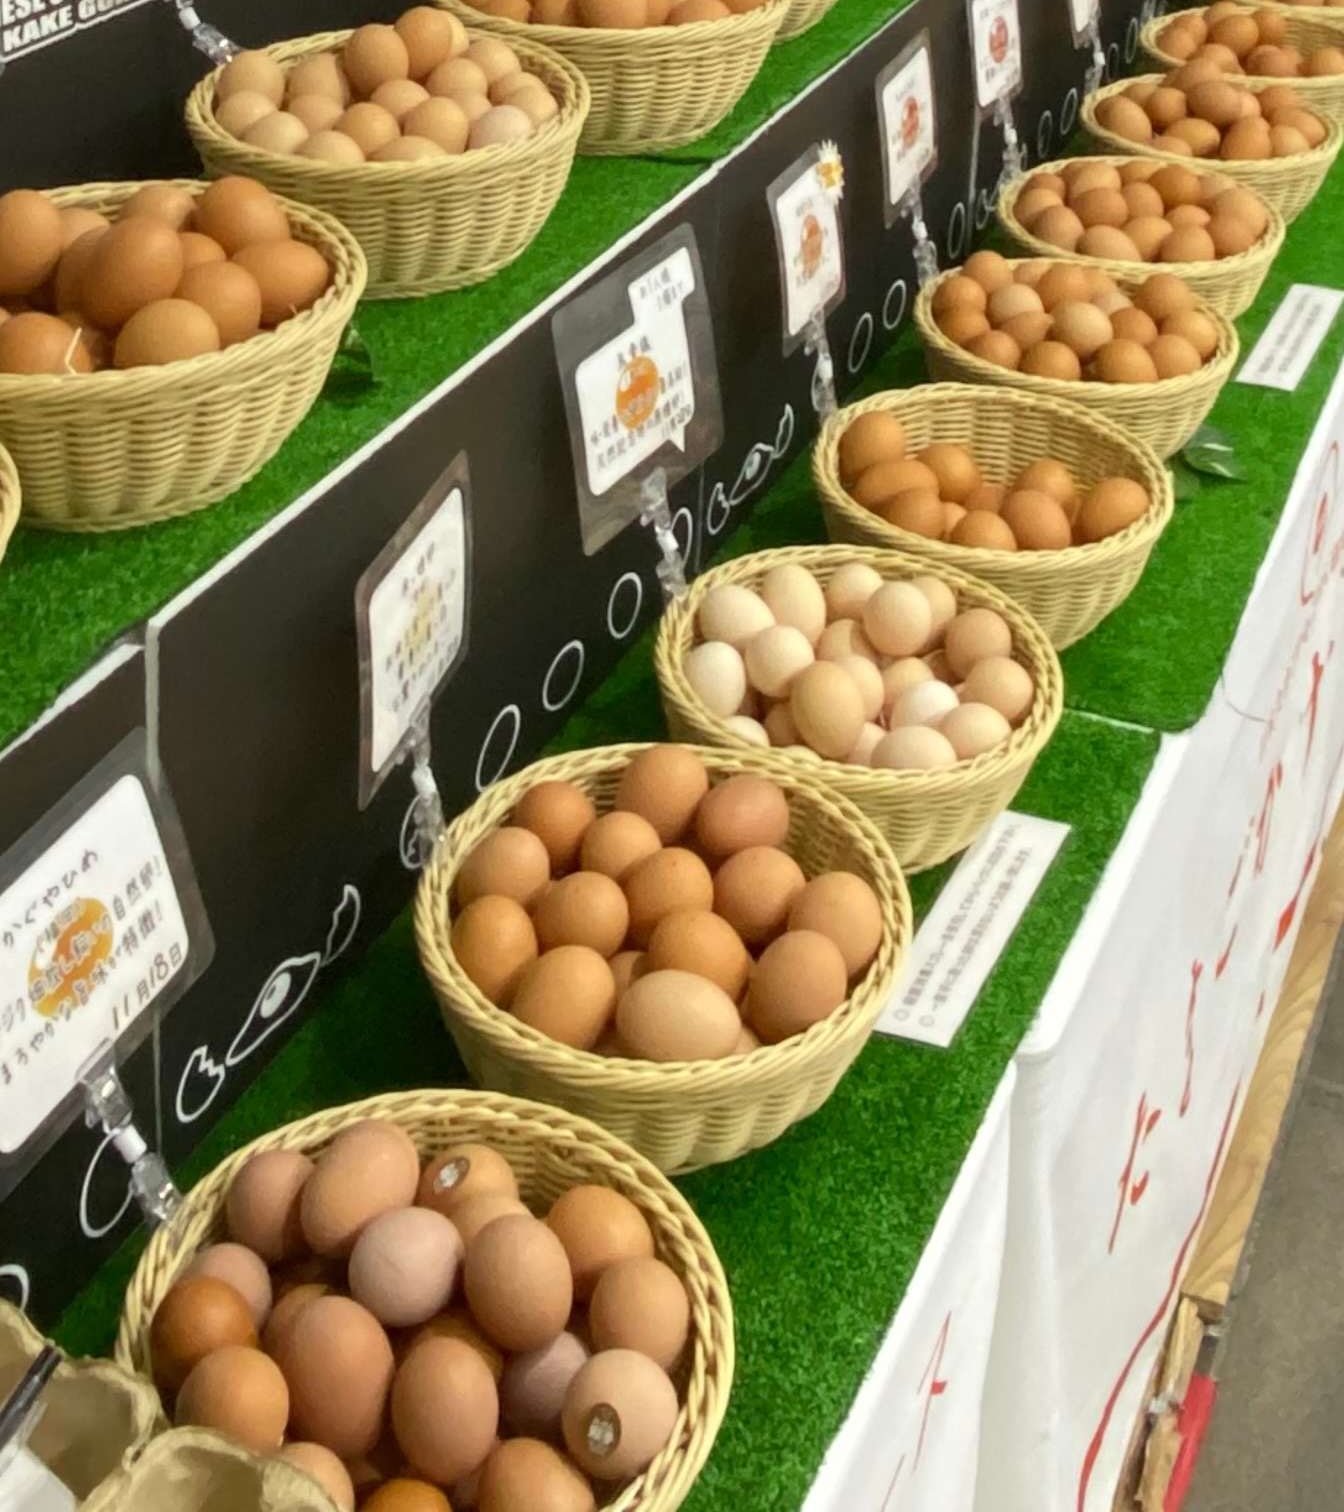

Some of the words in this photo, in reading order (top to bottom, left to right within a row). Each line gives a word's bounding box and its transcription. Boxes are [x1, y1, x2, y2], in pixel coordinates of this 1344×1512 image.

[3, 8, 73, 53] KAKE
[2, 849, 99, 948] かぐやひめ
[113, 941, 183, 1031] 11月18日
